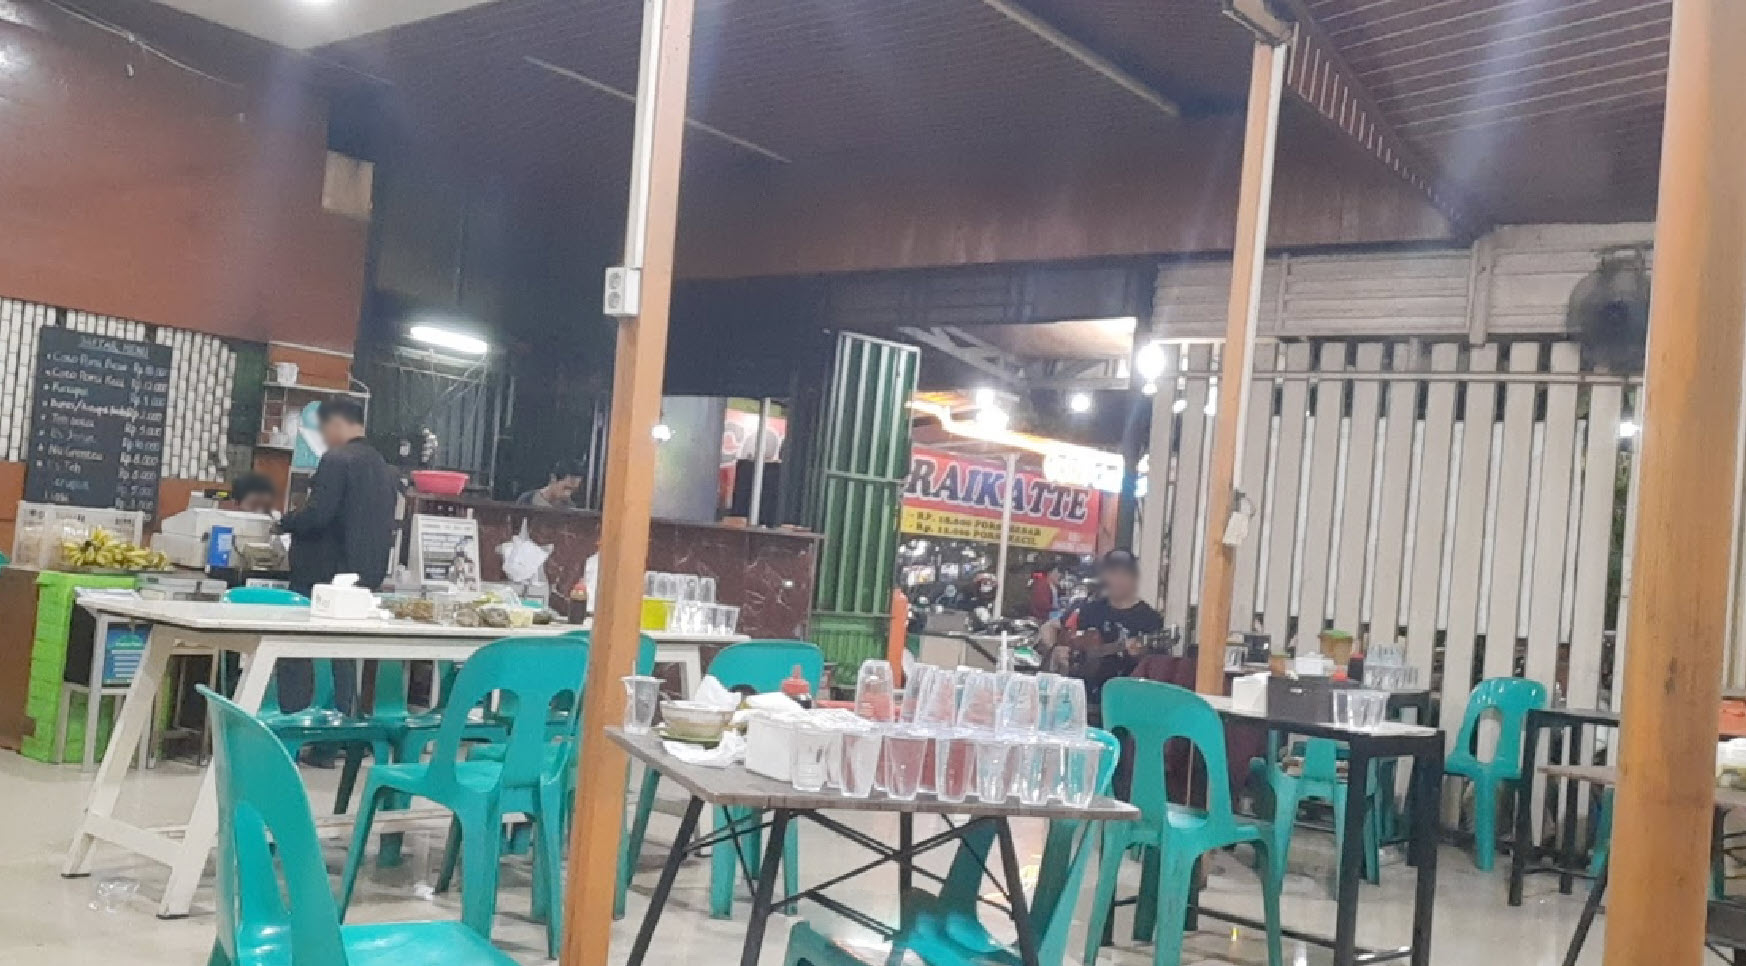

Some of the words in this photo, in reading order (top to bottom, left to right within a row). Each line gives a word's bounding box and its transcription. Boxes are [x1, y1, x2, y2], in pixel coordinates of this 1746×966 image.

[904, 457, 1088, 522] RAIKATTE
[974, 519, 1002, 531] PORS
[974, 529, 1001, 541] PORS
